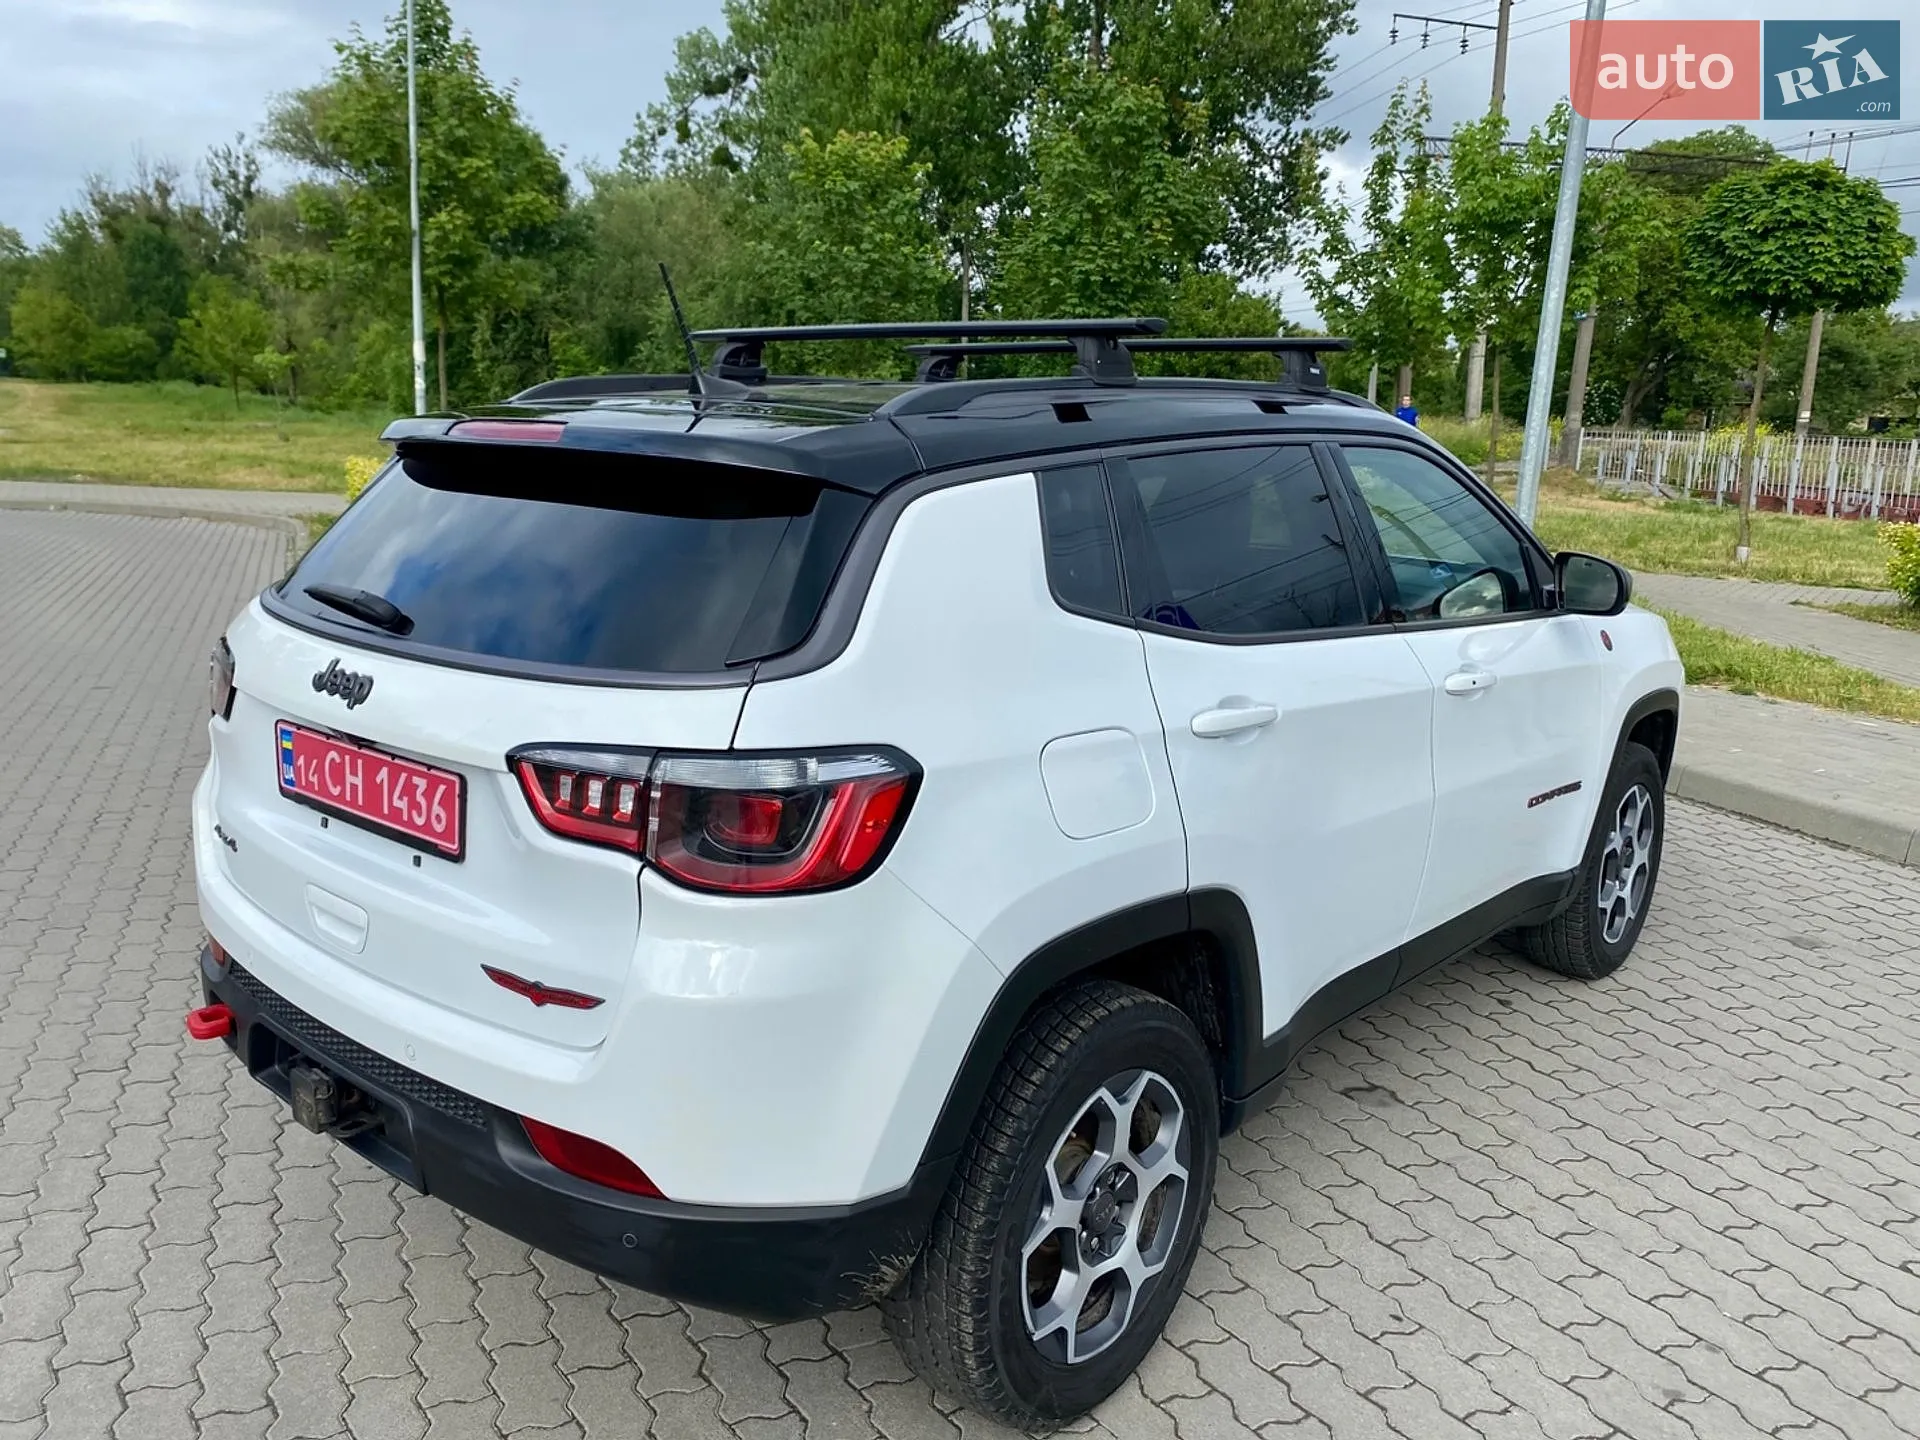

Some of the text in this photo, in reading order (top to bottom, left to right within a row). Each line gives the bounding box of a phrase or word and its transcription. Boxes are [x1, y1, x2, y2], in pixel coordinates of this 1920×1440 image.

[312, 657, 374, 710] Jeep
[283, 763, 294, 781] UA
[376, 766, 448, 833] 1436
